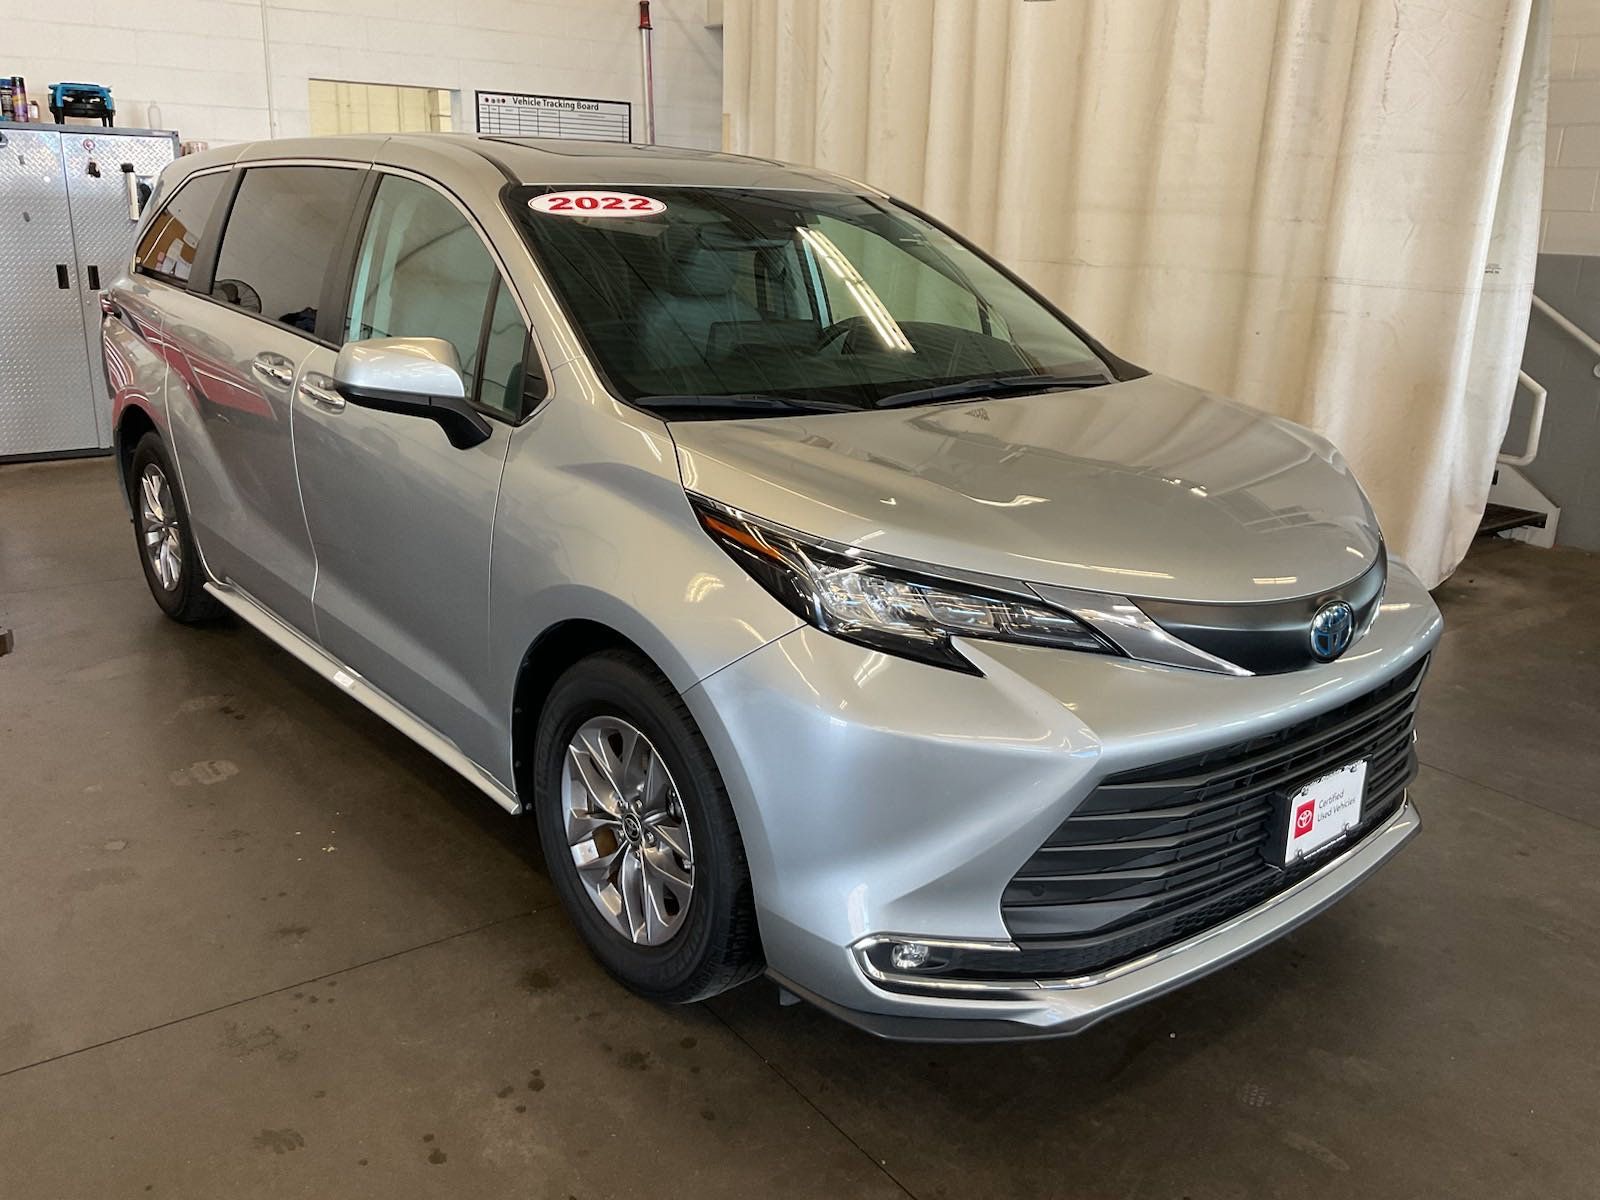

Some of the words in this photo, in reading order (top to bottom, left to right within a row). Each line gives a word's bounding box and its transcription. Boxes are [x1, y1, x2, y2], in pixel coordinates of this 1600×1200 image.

[512, 97, 541, 107] Vehicle
[542, 99, 575, 112] Tracking
[576, 102, 599, 111] Board
[548, 197, 652, 210] 2022
[1318, 789, 1345, 809] Certified
[1317, 809, 1332, 822] Used
[1333, 797, 1356, 814] Vehicles
